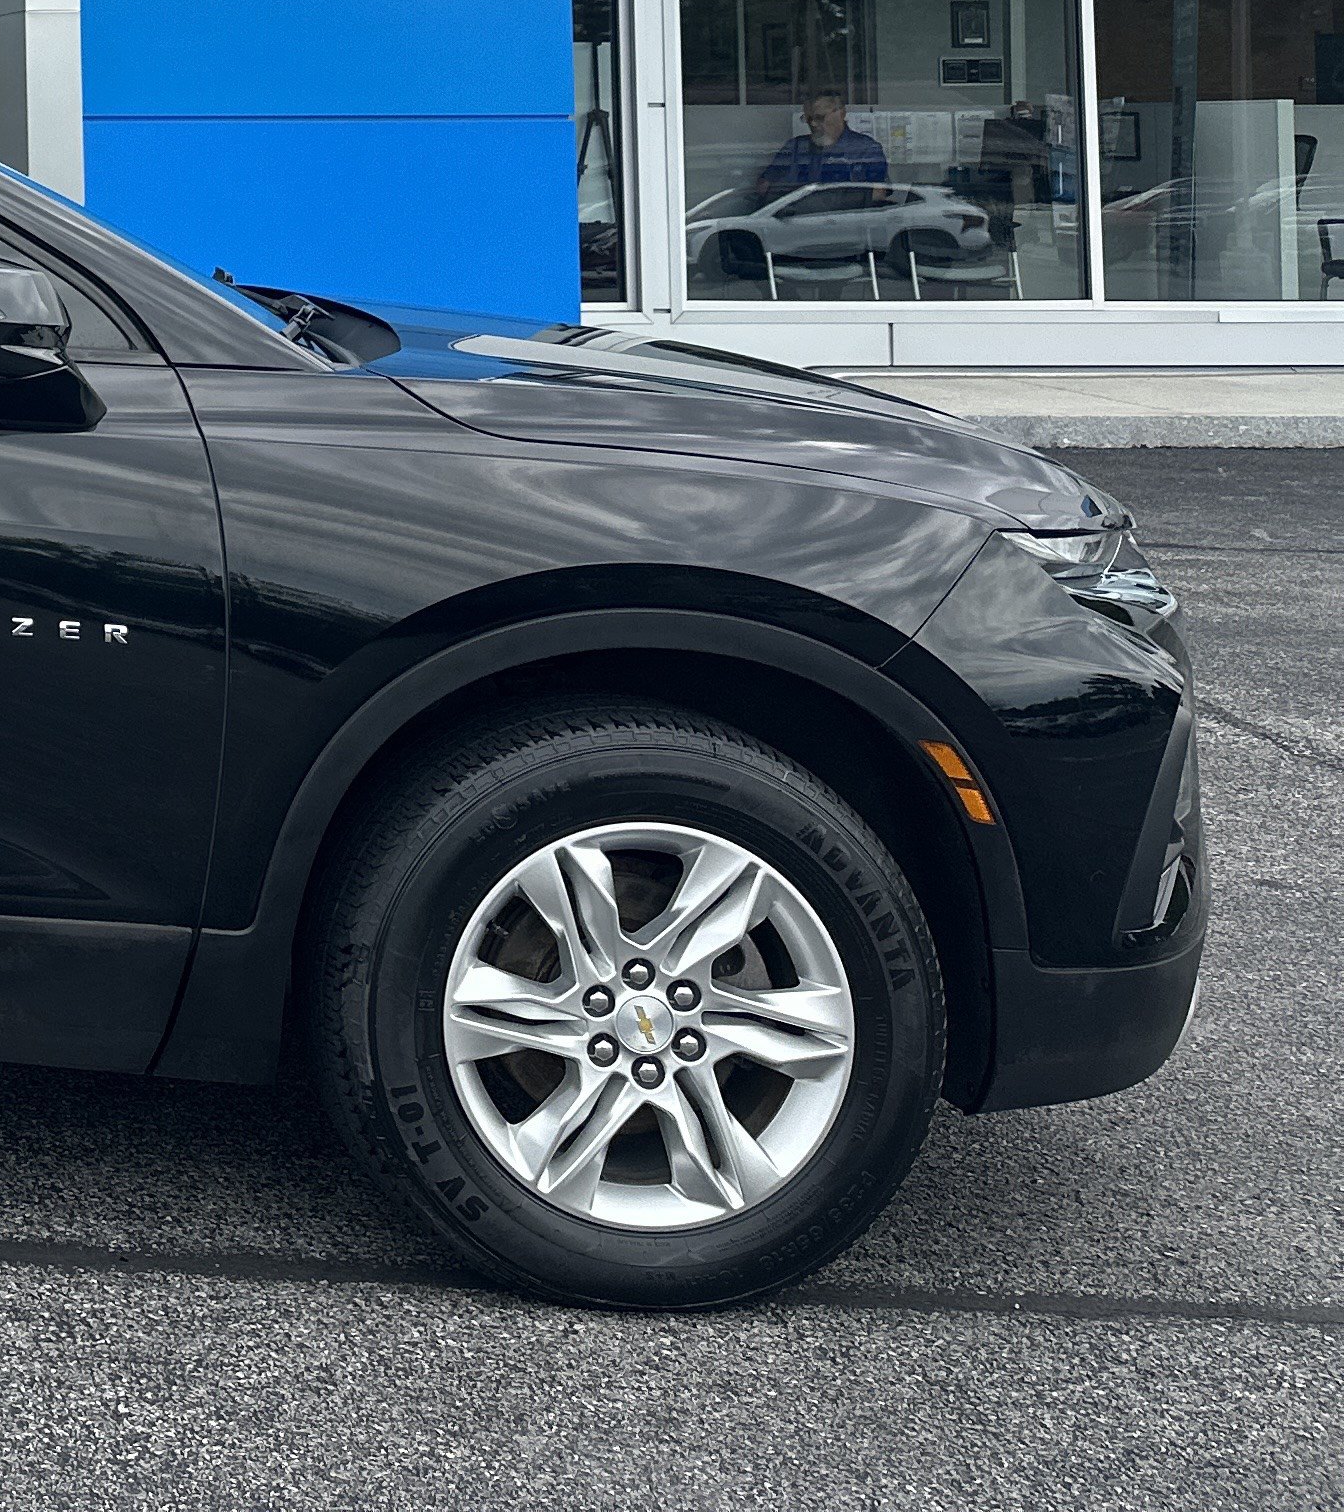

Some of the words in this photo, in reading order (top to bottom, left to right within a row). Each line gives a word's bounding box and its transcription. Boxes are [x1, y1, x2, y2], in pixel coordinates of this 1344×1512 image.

[797, 820, 915, 991] ADVANTA
[390, 1082, 444, 1165] T-01
[433, 1168, 491, 1226] SV
